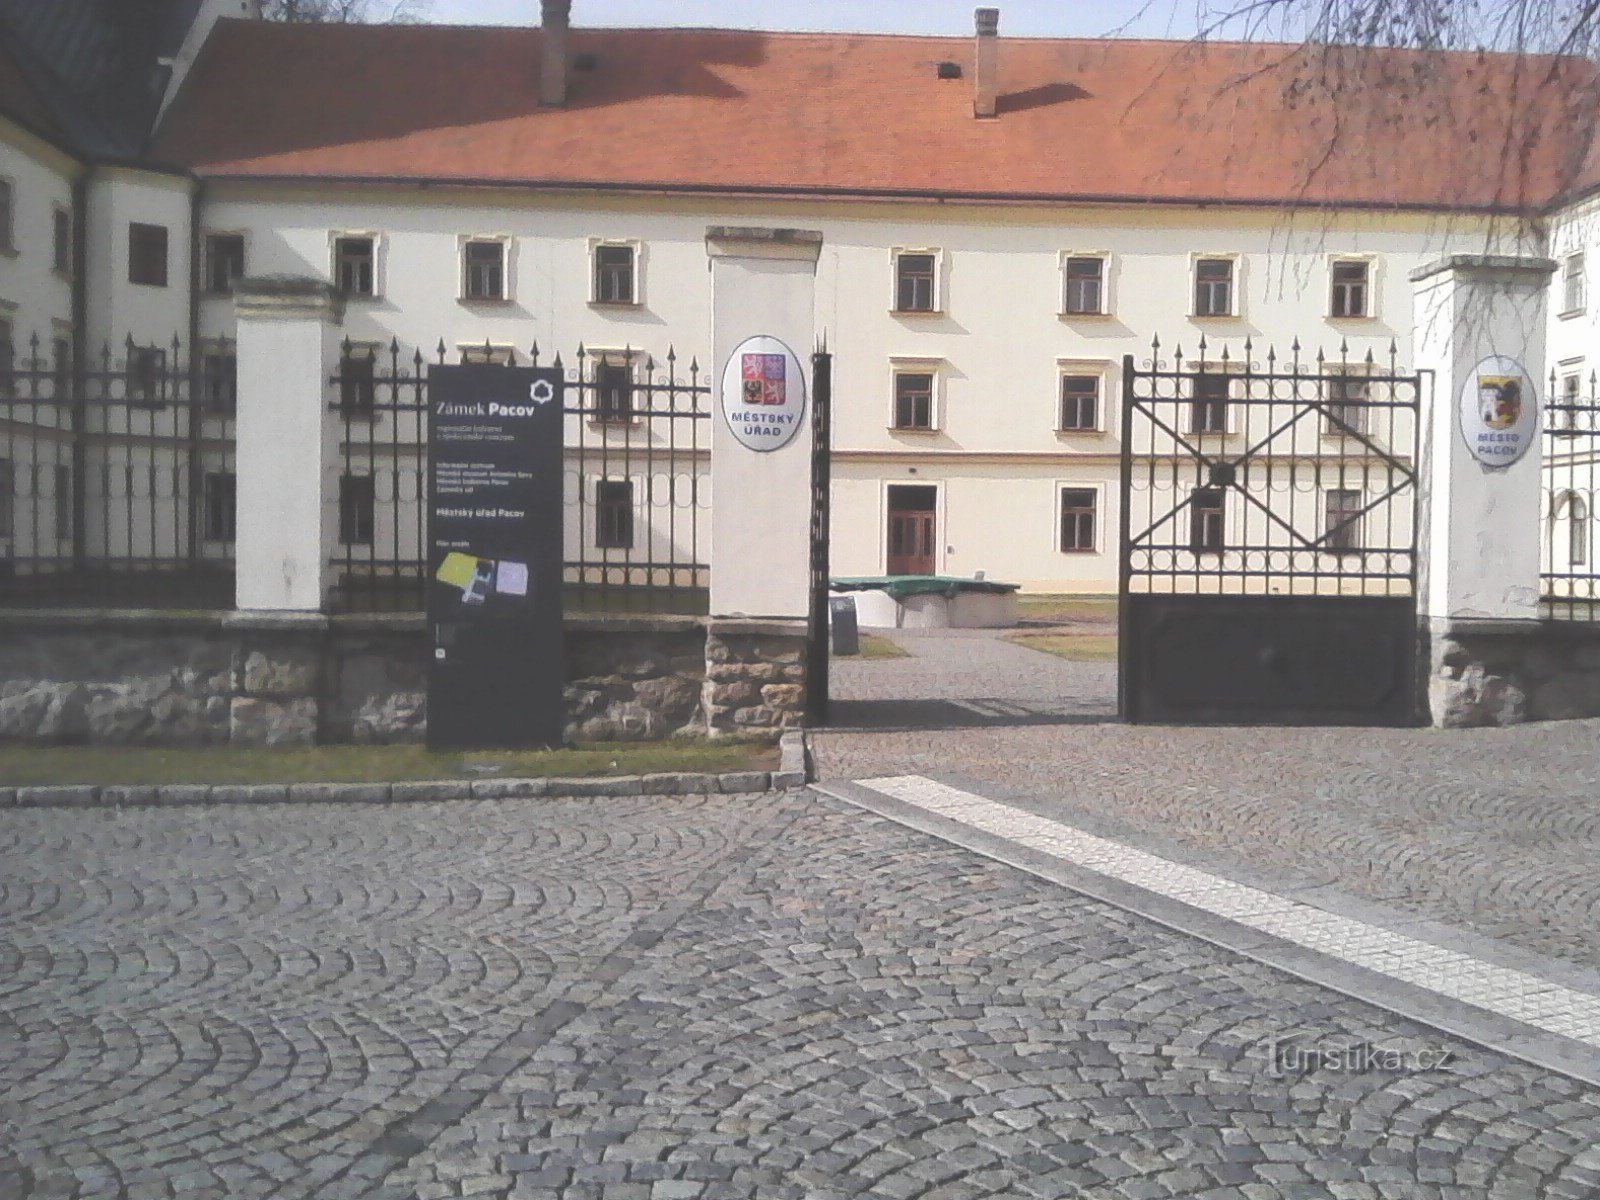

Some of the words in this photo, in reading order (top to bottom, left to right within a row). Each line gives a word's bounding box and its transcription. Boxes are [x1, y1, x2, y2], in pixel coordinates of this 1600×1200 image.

[435, 401, 485, 416] Zámek
[488, 402, 535, 417] Pacov
[731, 411, 795, 424] MĚSTSKÝ
[744, 423, 782, 436] ÚŘAD
[1478, 445, 1518, 455] PACOV
